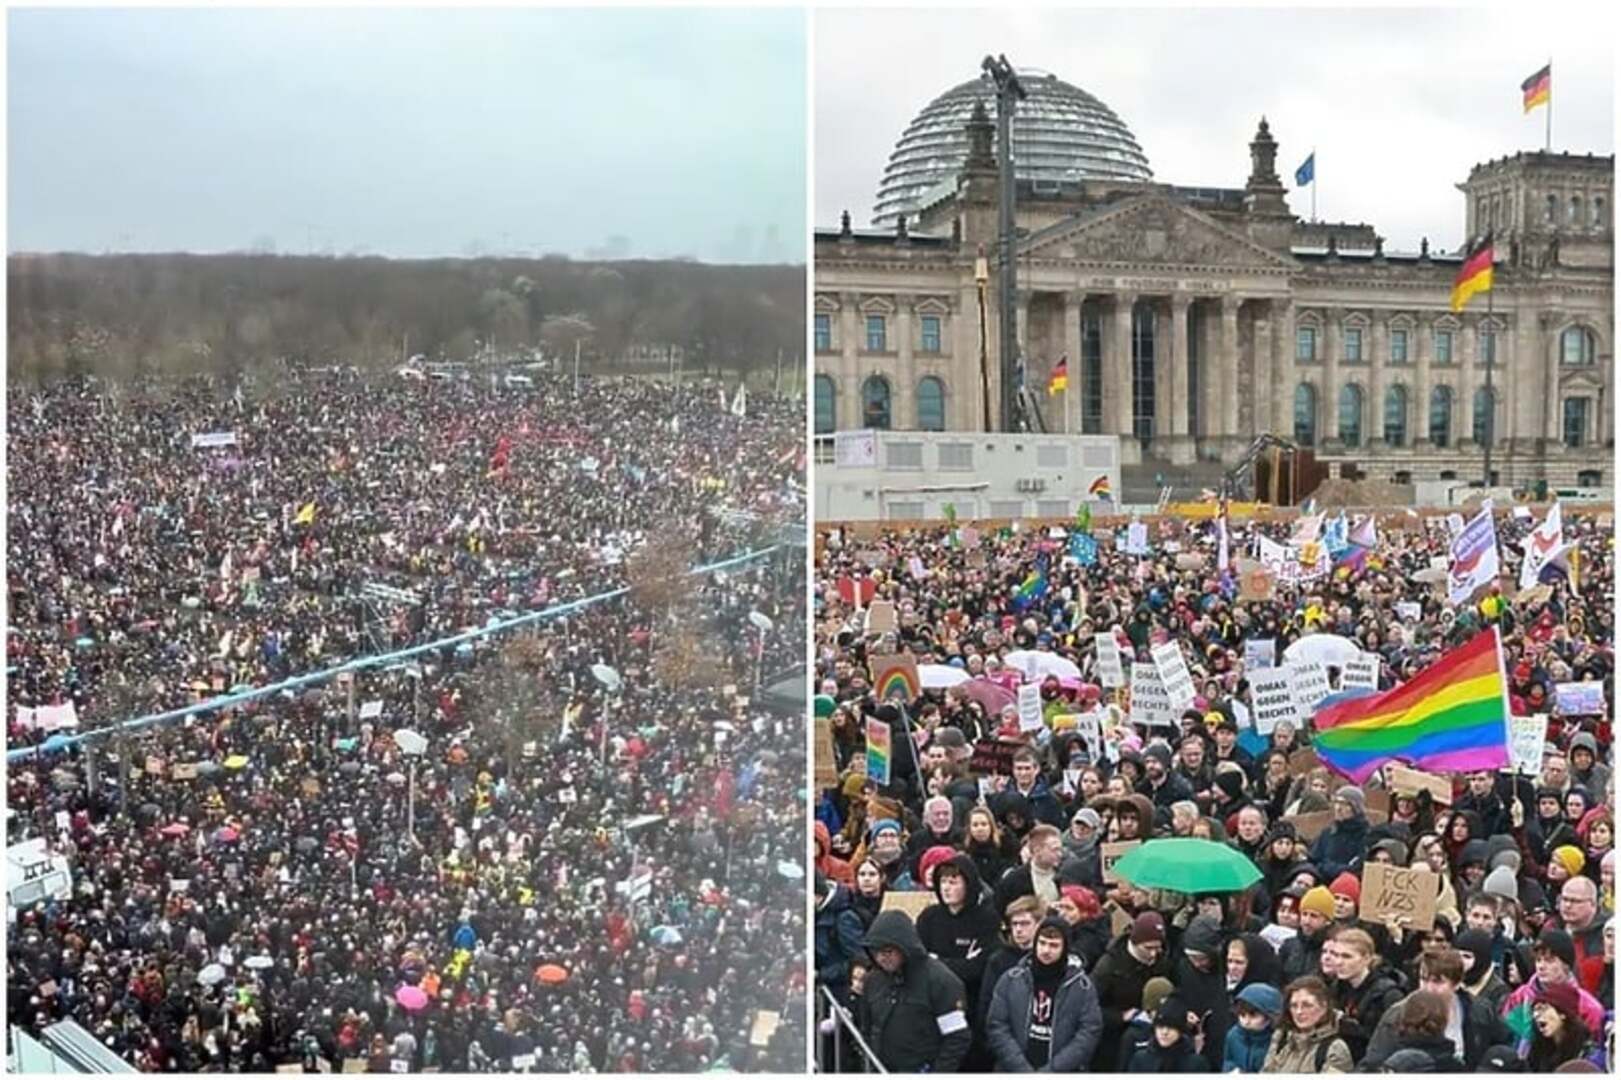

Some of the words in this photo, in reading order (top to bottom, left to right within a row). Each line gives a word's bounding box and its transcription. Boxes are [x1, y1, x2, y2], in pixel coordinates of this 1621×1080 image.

[1255, 680, 1288, 693] OMAS
[1132, 700, 1170, 711] RECHTS
[1256, 693, 1291, 706] GEGEN
[1258, 705, 1297, 719] RECHTS
[1382, 867, 1420, 893] FCK
[1375, 889, 1416, 913] NZS
